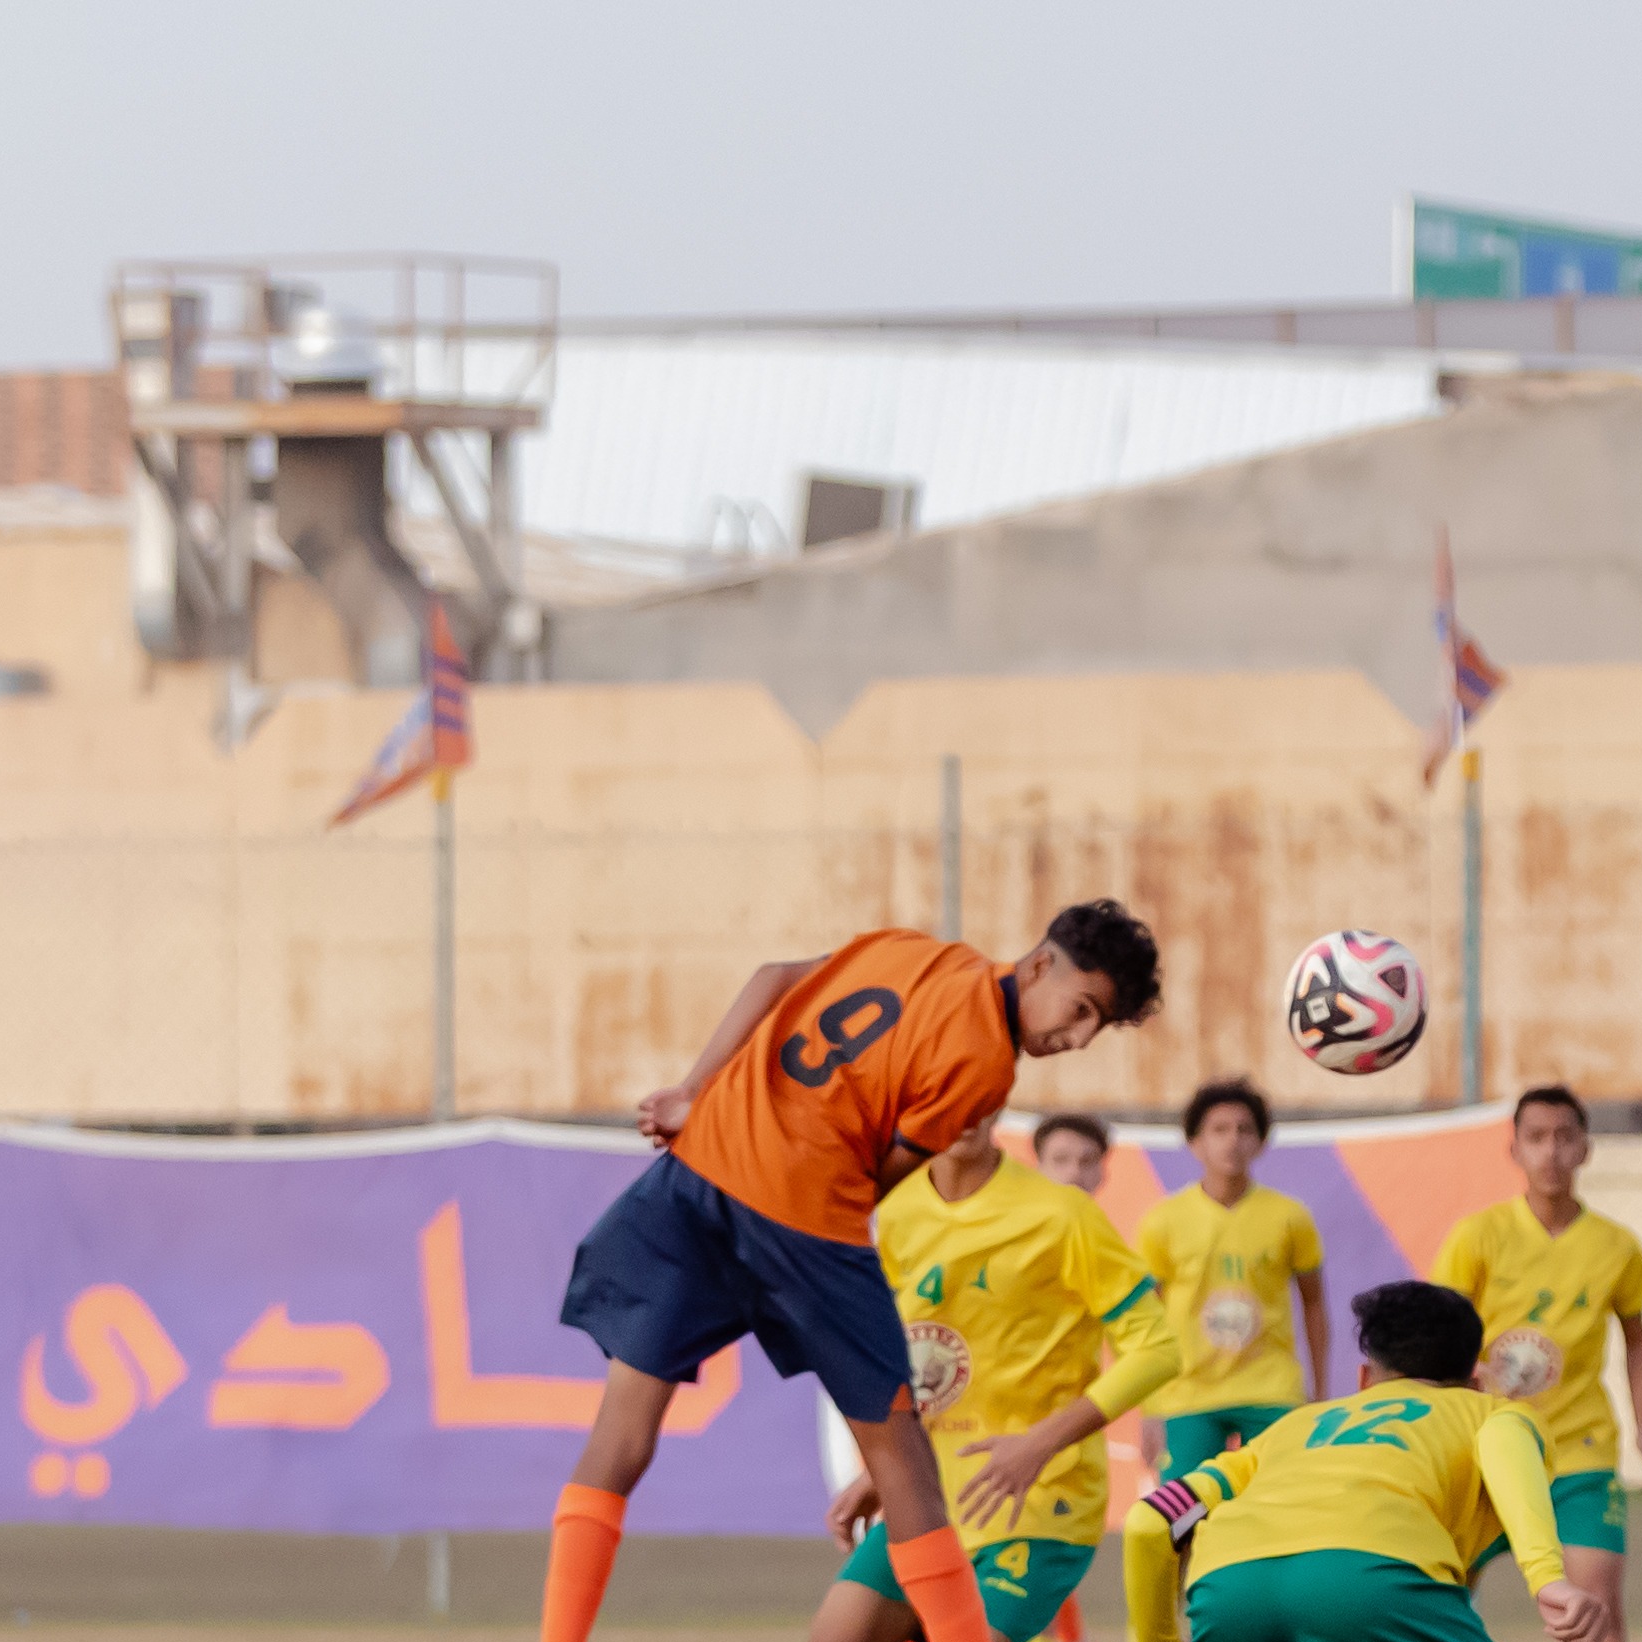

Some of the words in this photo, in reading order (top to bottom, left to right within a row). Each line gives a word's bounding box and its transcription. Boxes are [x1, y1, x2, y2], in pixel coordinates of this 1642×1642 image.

[779, 985, 904, 1089] 9
[916, 1264, 944, 1306] 4
[20, 1199, 743, 1499] ادي
[1305, 1397, 1433, 1451] 12
[994, 1540, 1031, 1580] 4
